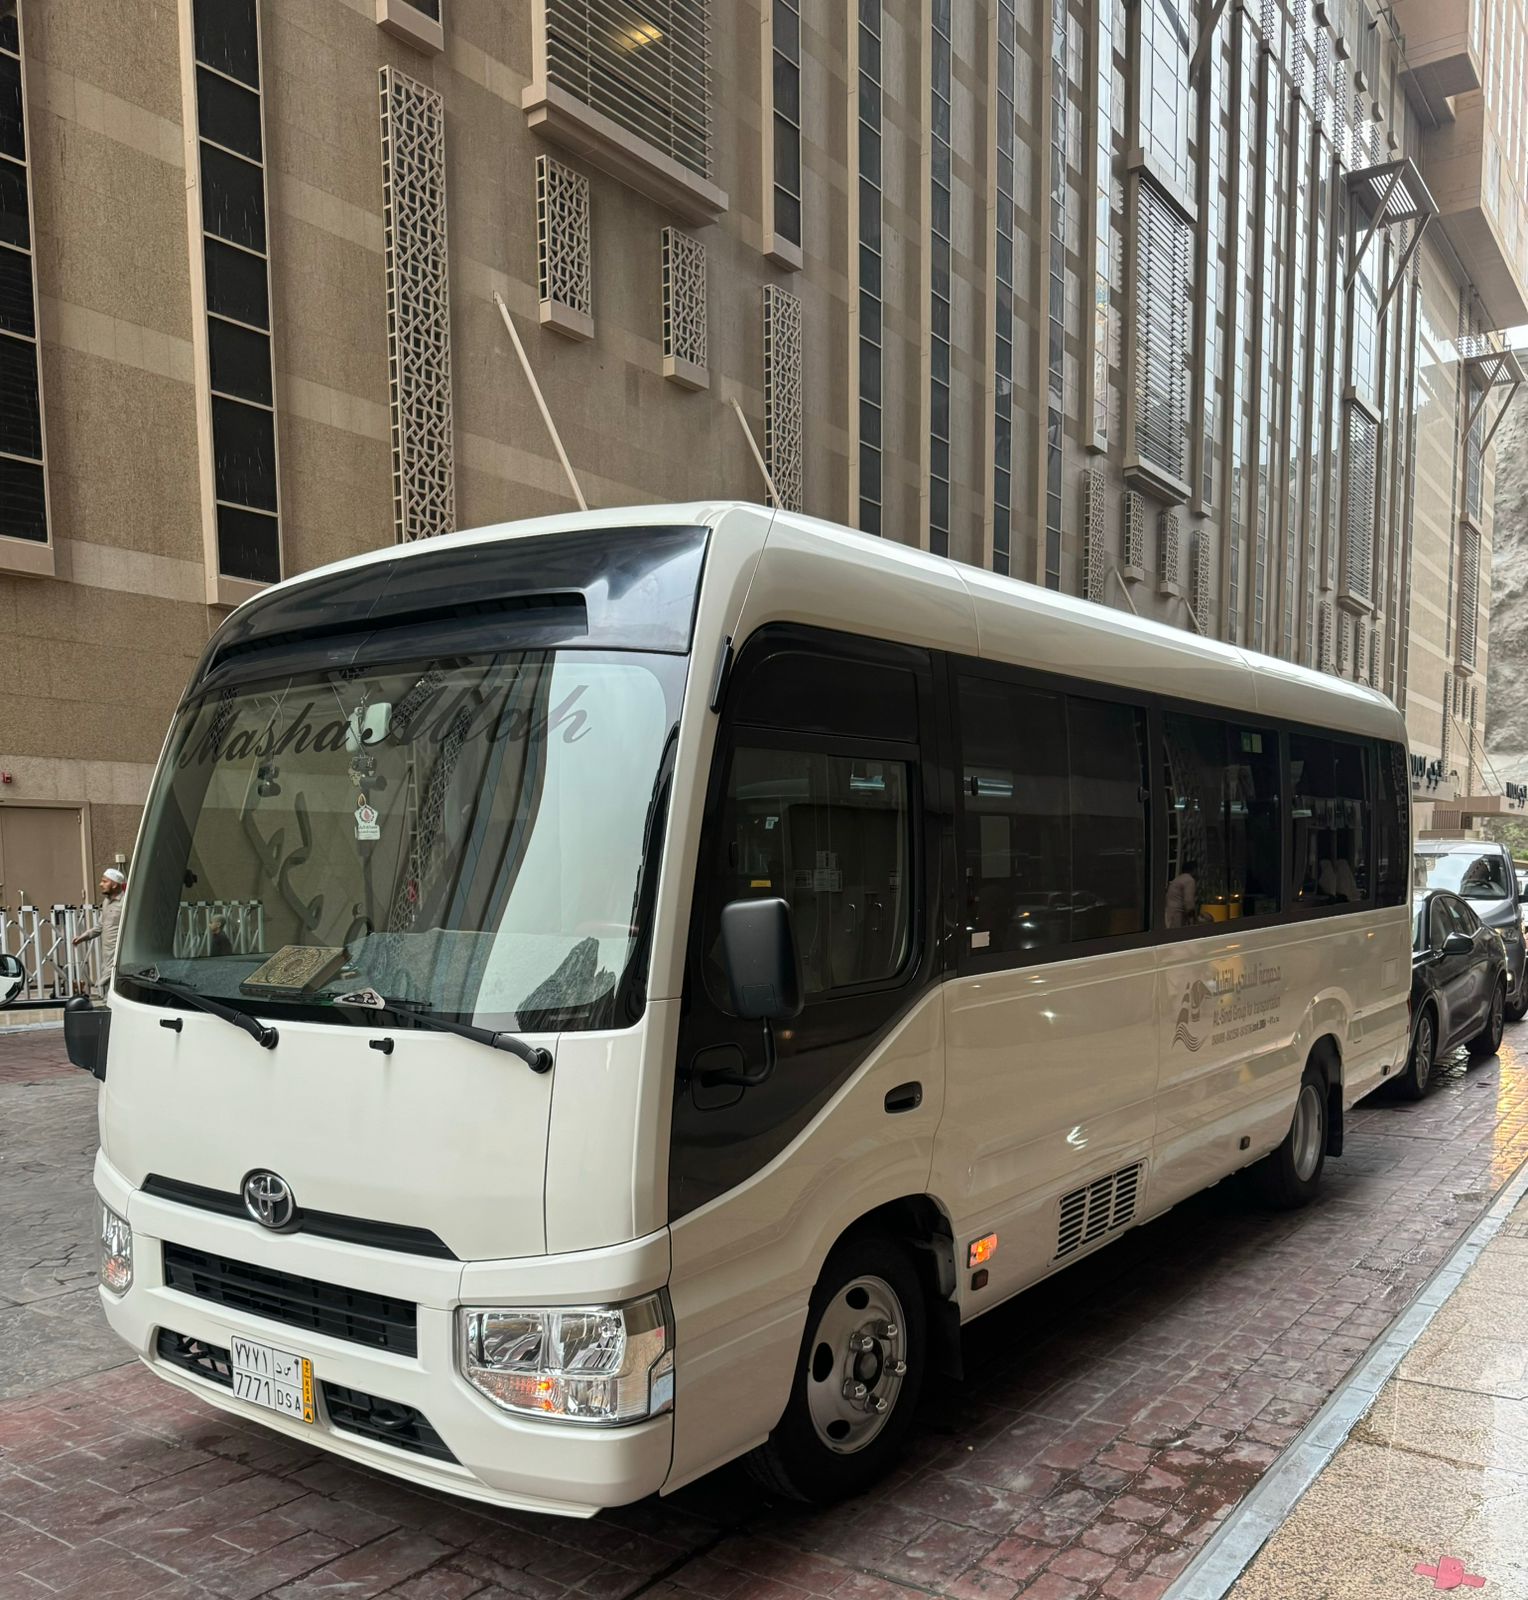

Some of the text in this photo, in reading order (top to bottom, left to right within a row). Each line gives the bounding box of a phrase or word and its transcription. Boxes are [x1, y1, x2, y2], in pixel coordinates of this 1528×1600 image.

[179, 685, 592, 769] Masha Allah
[235, 1371, 271, 1405] 7771
